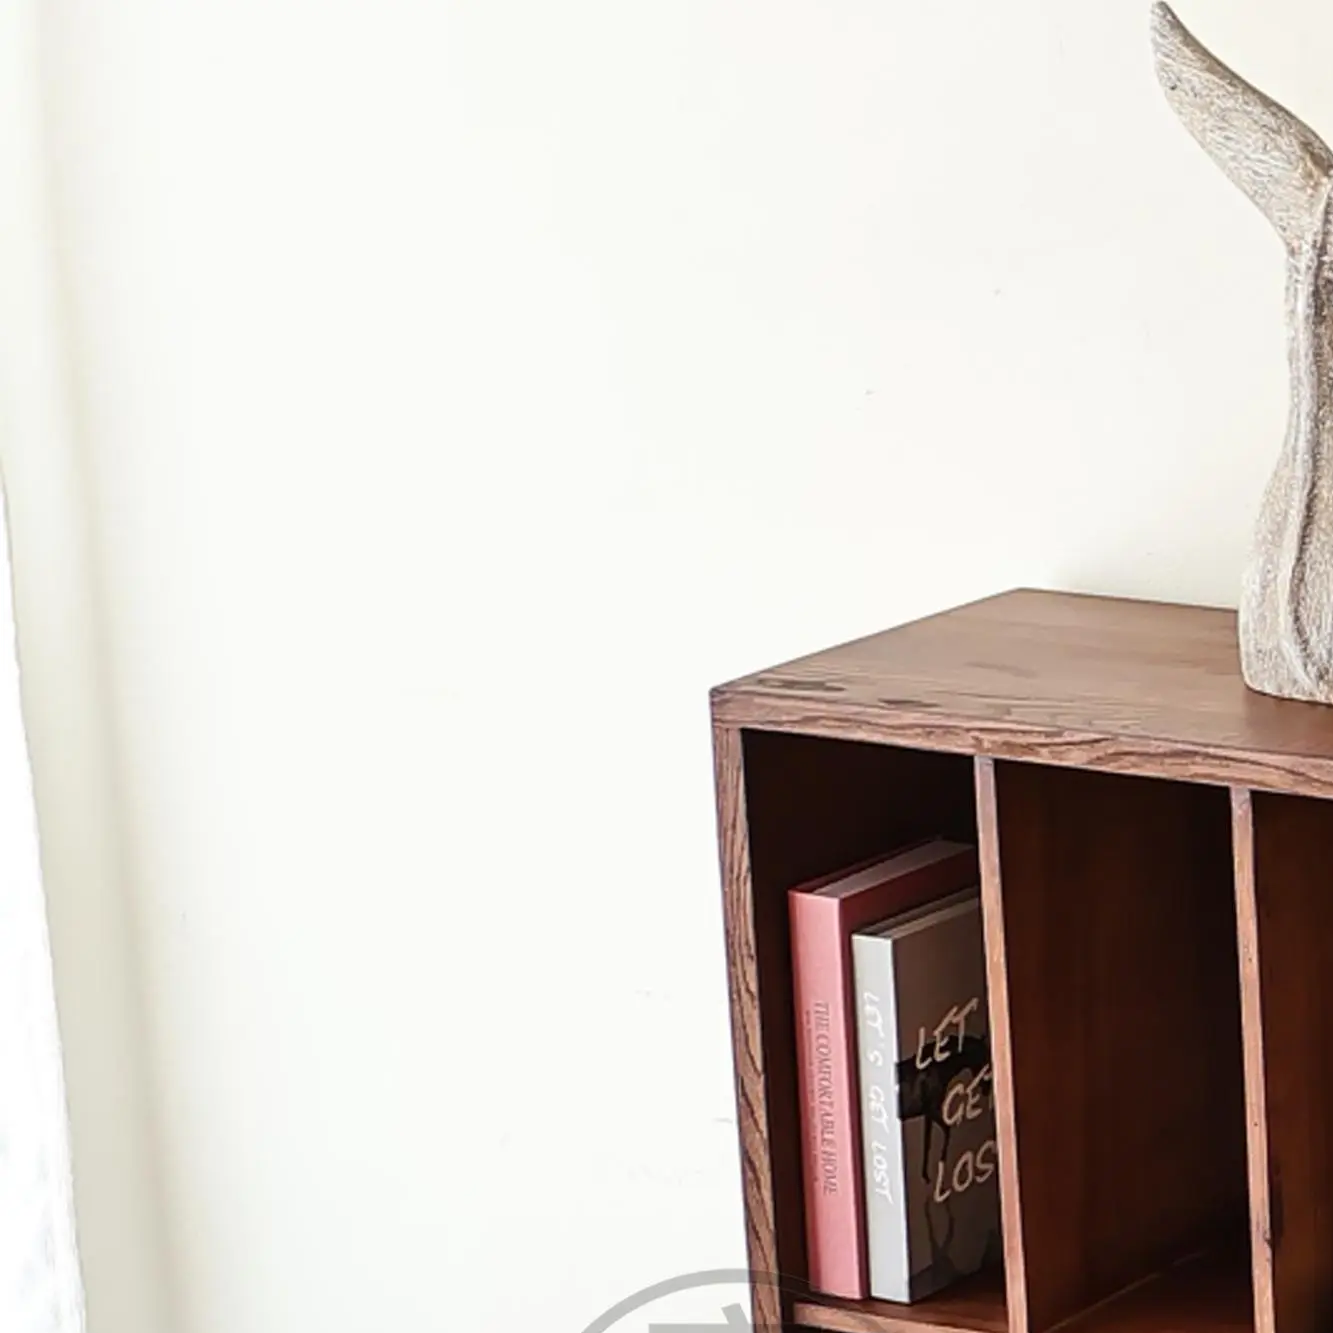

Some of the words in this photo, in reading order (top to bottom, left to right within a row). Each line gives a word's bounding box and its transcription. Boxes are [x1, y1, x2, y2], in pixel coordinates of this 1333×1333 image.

[813, 1001, 831, 1031] THE
[914, 996, 979, 1070] LET
[815, 1034, 835, 1148] COMFORTABLE
[868, 1085, 890, 1134] GET
[821, 1149, 838, 1197] HOME
[871, 1140, 893, 1206] LOST
[932, 1138, 997, 1204] LOS
